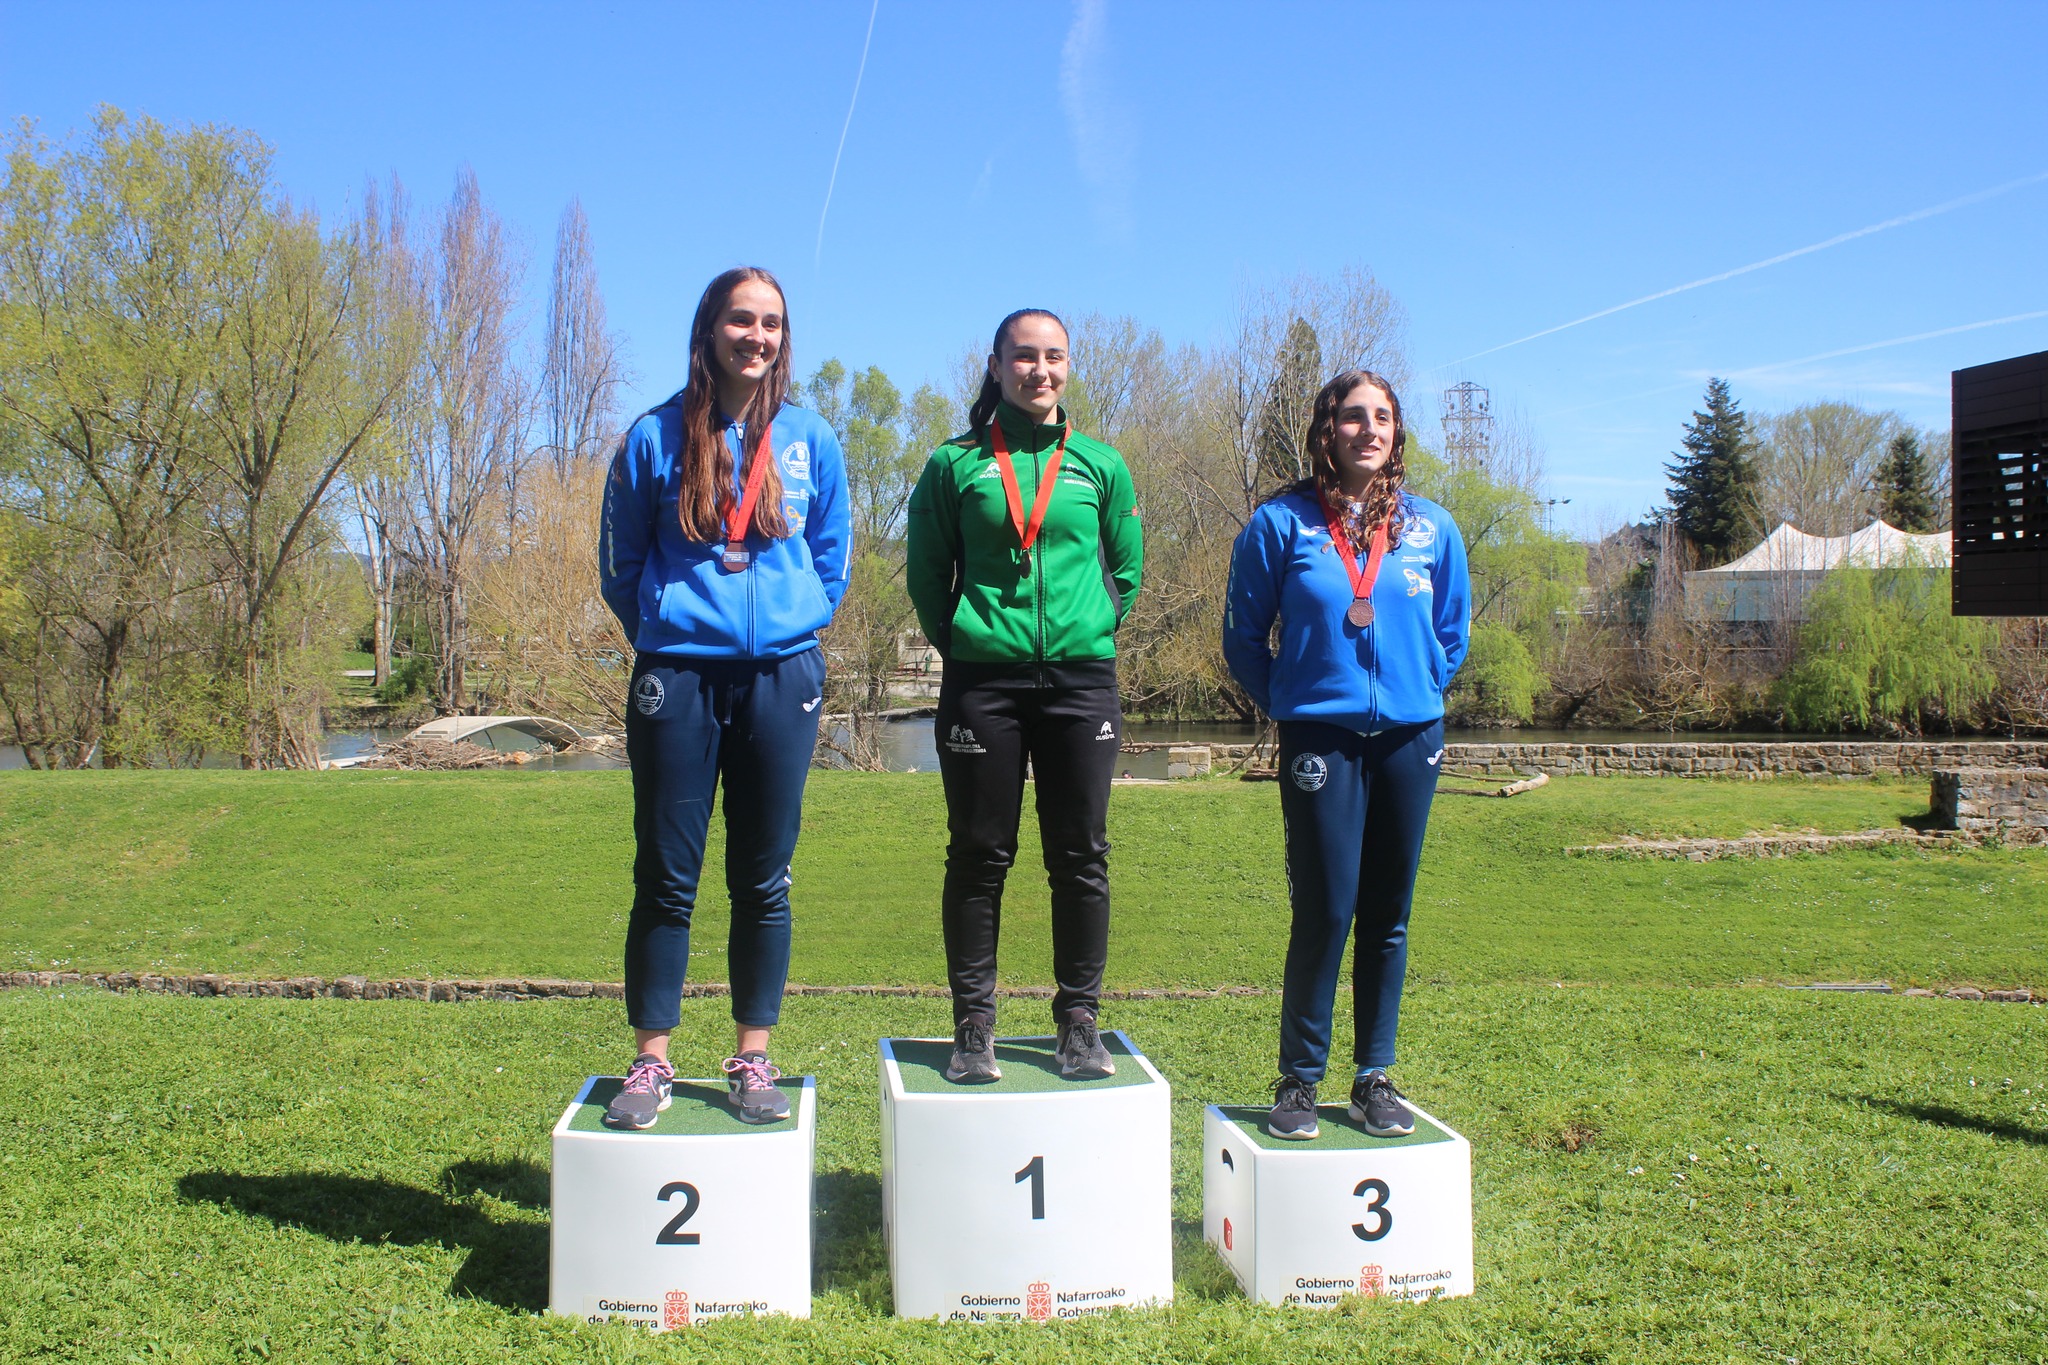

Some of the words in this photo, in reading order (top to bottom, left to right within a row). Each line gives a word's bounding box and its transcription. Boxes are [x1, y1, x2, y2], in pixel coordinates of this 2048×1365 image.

[1014, 1155, 1045, 1220] 1
[655, 1181, 701, 1245] 2
[1351, 1178, 1393, 1242] 3
[1295, 1277, 1354, 1289] Gobierno
[1389, 1269, 1452, 1285] Nafarroako
[961, 1294, 1021, 1306] Gobierno
[1057, 1287, 1126, 1303] Nafarroako
[598, 1299, 658, 1313] Gobierno
[950, 1310, 966, 1321] de
